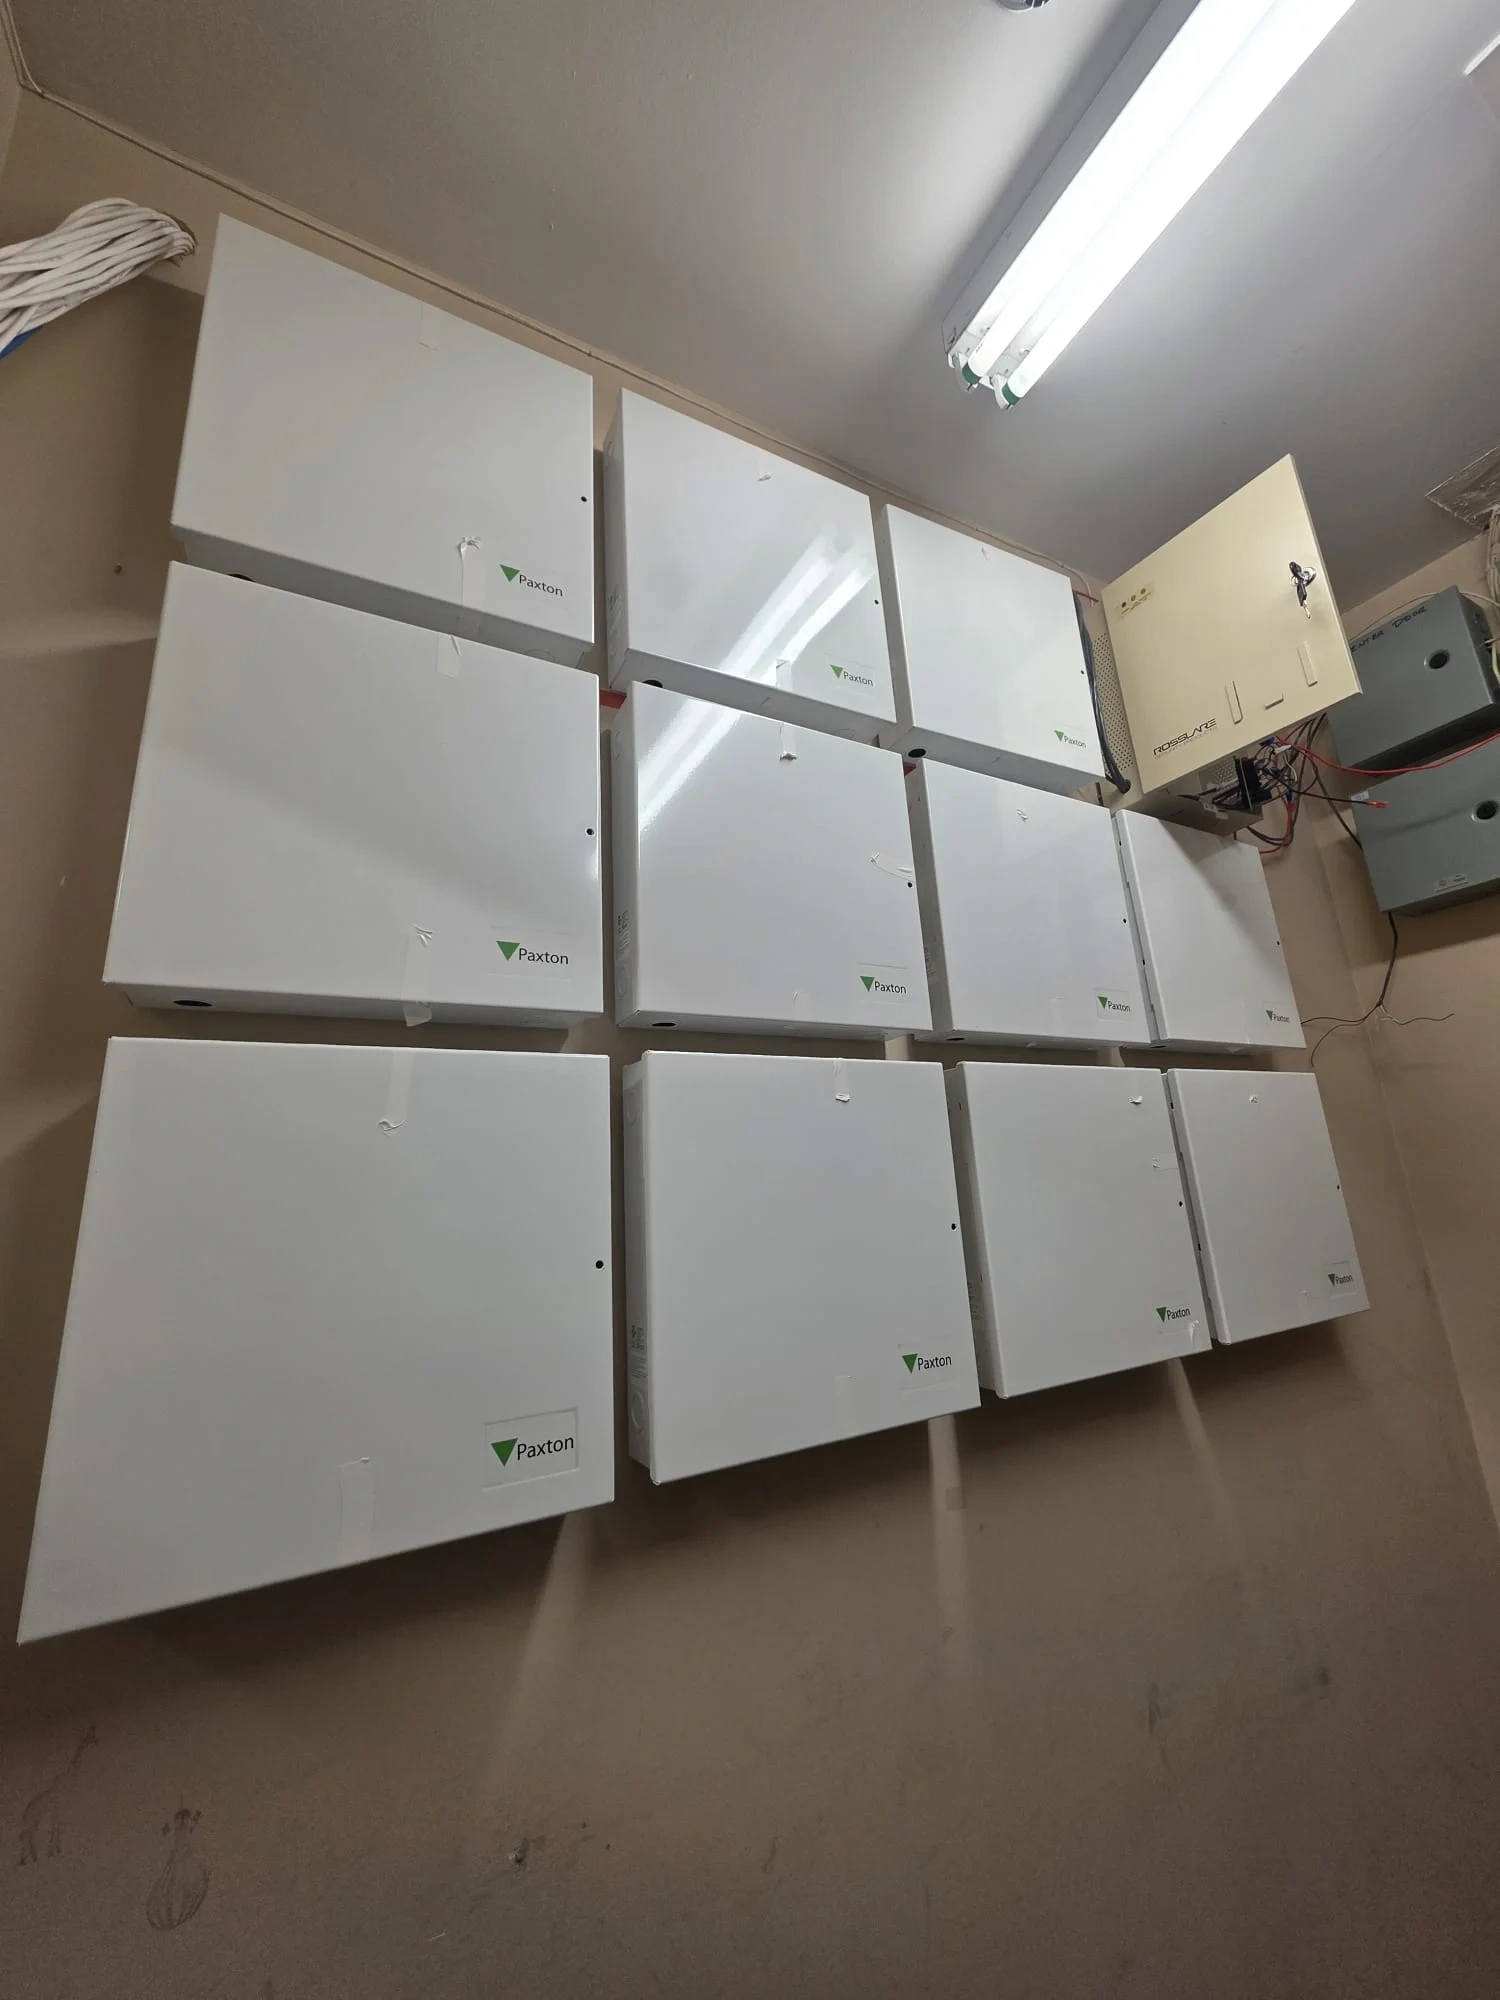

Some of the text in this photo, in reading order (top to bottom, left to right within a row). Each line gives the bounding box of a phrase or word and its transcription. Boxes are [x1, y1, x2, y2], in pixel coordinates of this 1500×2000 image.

[519, 574, 563, 597] Paxton
[843, 671, 873, 687] Paxton
[1153, 718, 1217, 755] ROSSLARE
[519, 947, 569, 965] Paxton
[874, 980, 907, 995] Paxton
[1107, 1000, 1130, 1013] Paxton
[1166, 1308, 1191, 1320] Paxton
[917, 1356, 952, 1371] Paxton
[517, 1437, 574, 1461] Paxton
